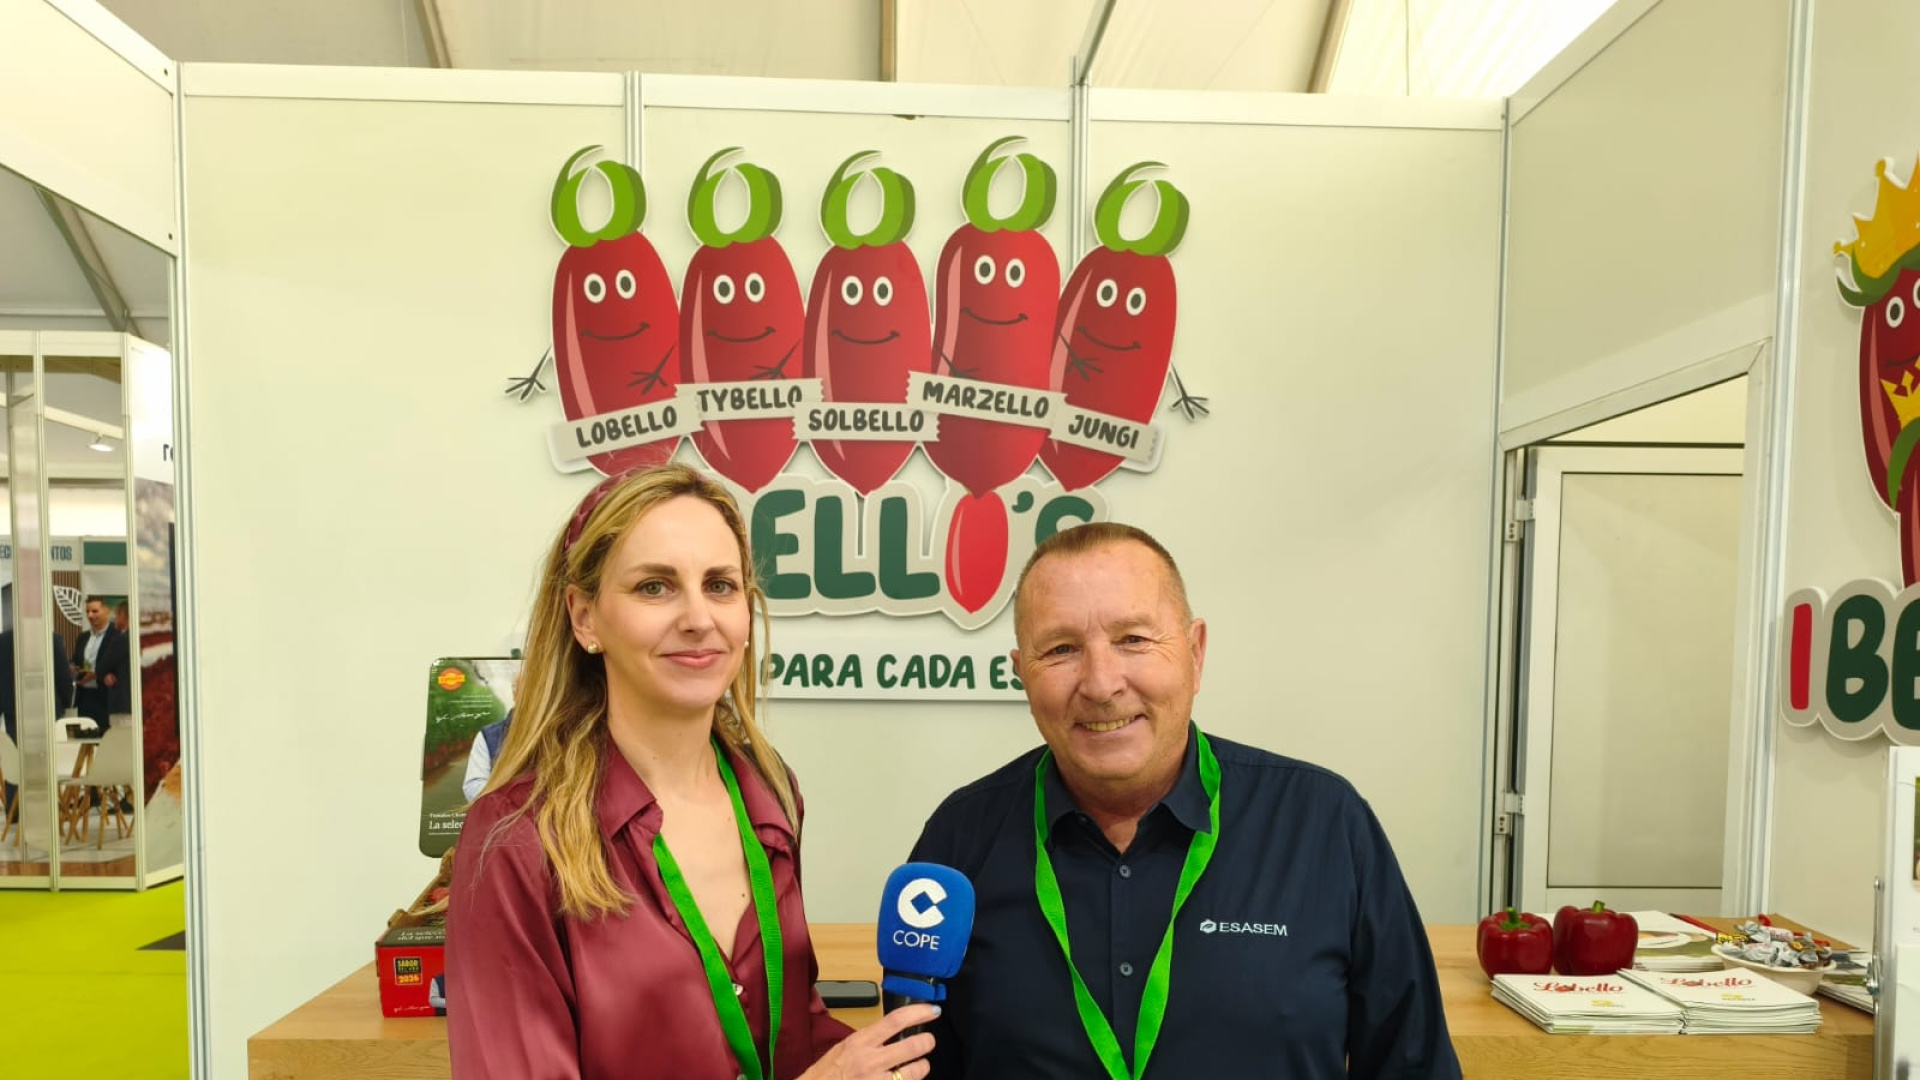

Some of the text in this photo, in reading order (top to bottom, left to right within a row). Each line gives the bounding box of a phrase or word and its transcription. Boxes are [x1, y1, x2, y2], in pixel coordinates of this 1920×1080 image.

[696, 385, 802, 413] TYBELLO
[922, 380, 1050, 419] MARZELLO
[576, 405, 678, 448] LOBELLO
[808, 409, 924, 433] SOLBELLO
[1068, 414, 1139, 449] JUNGI
[760, 653, 863, 689] PARA
[877, 654, 976, 690] CADA
[429, 821, 440, 830] La
[893, 930, 940, 950] COPE
[1219, 922, 1288, 937] ESASEM
